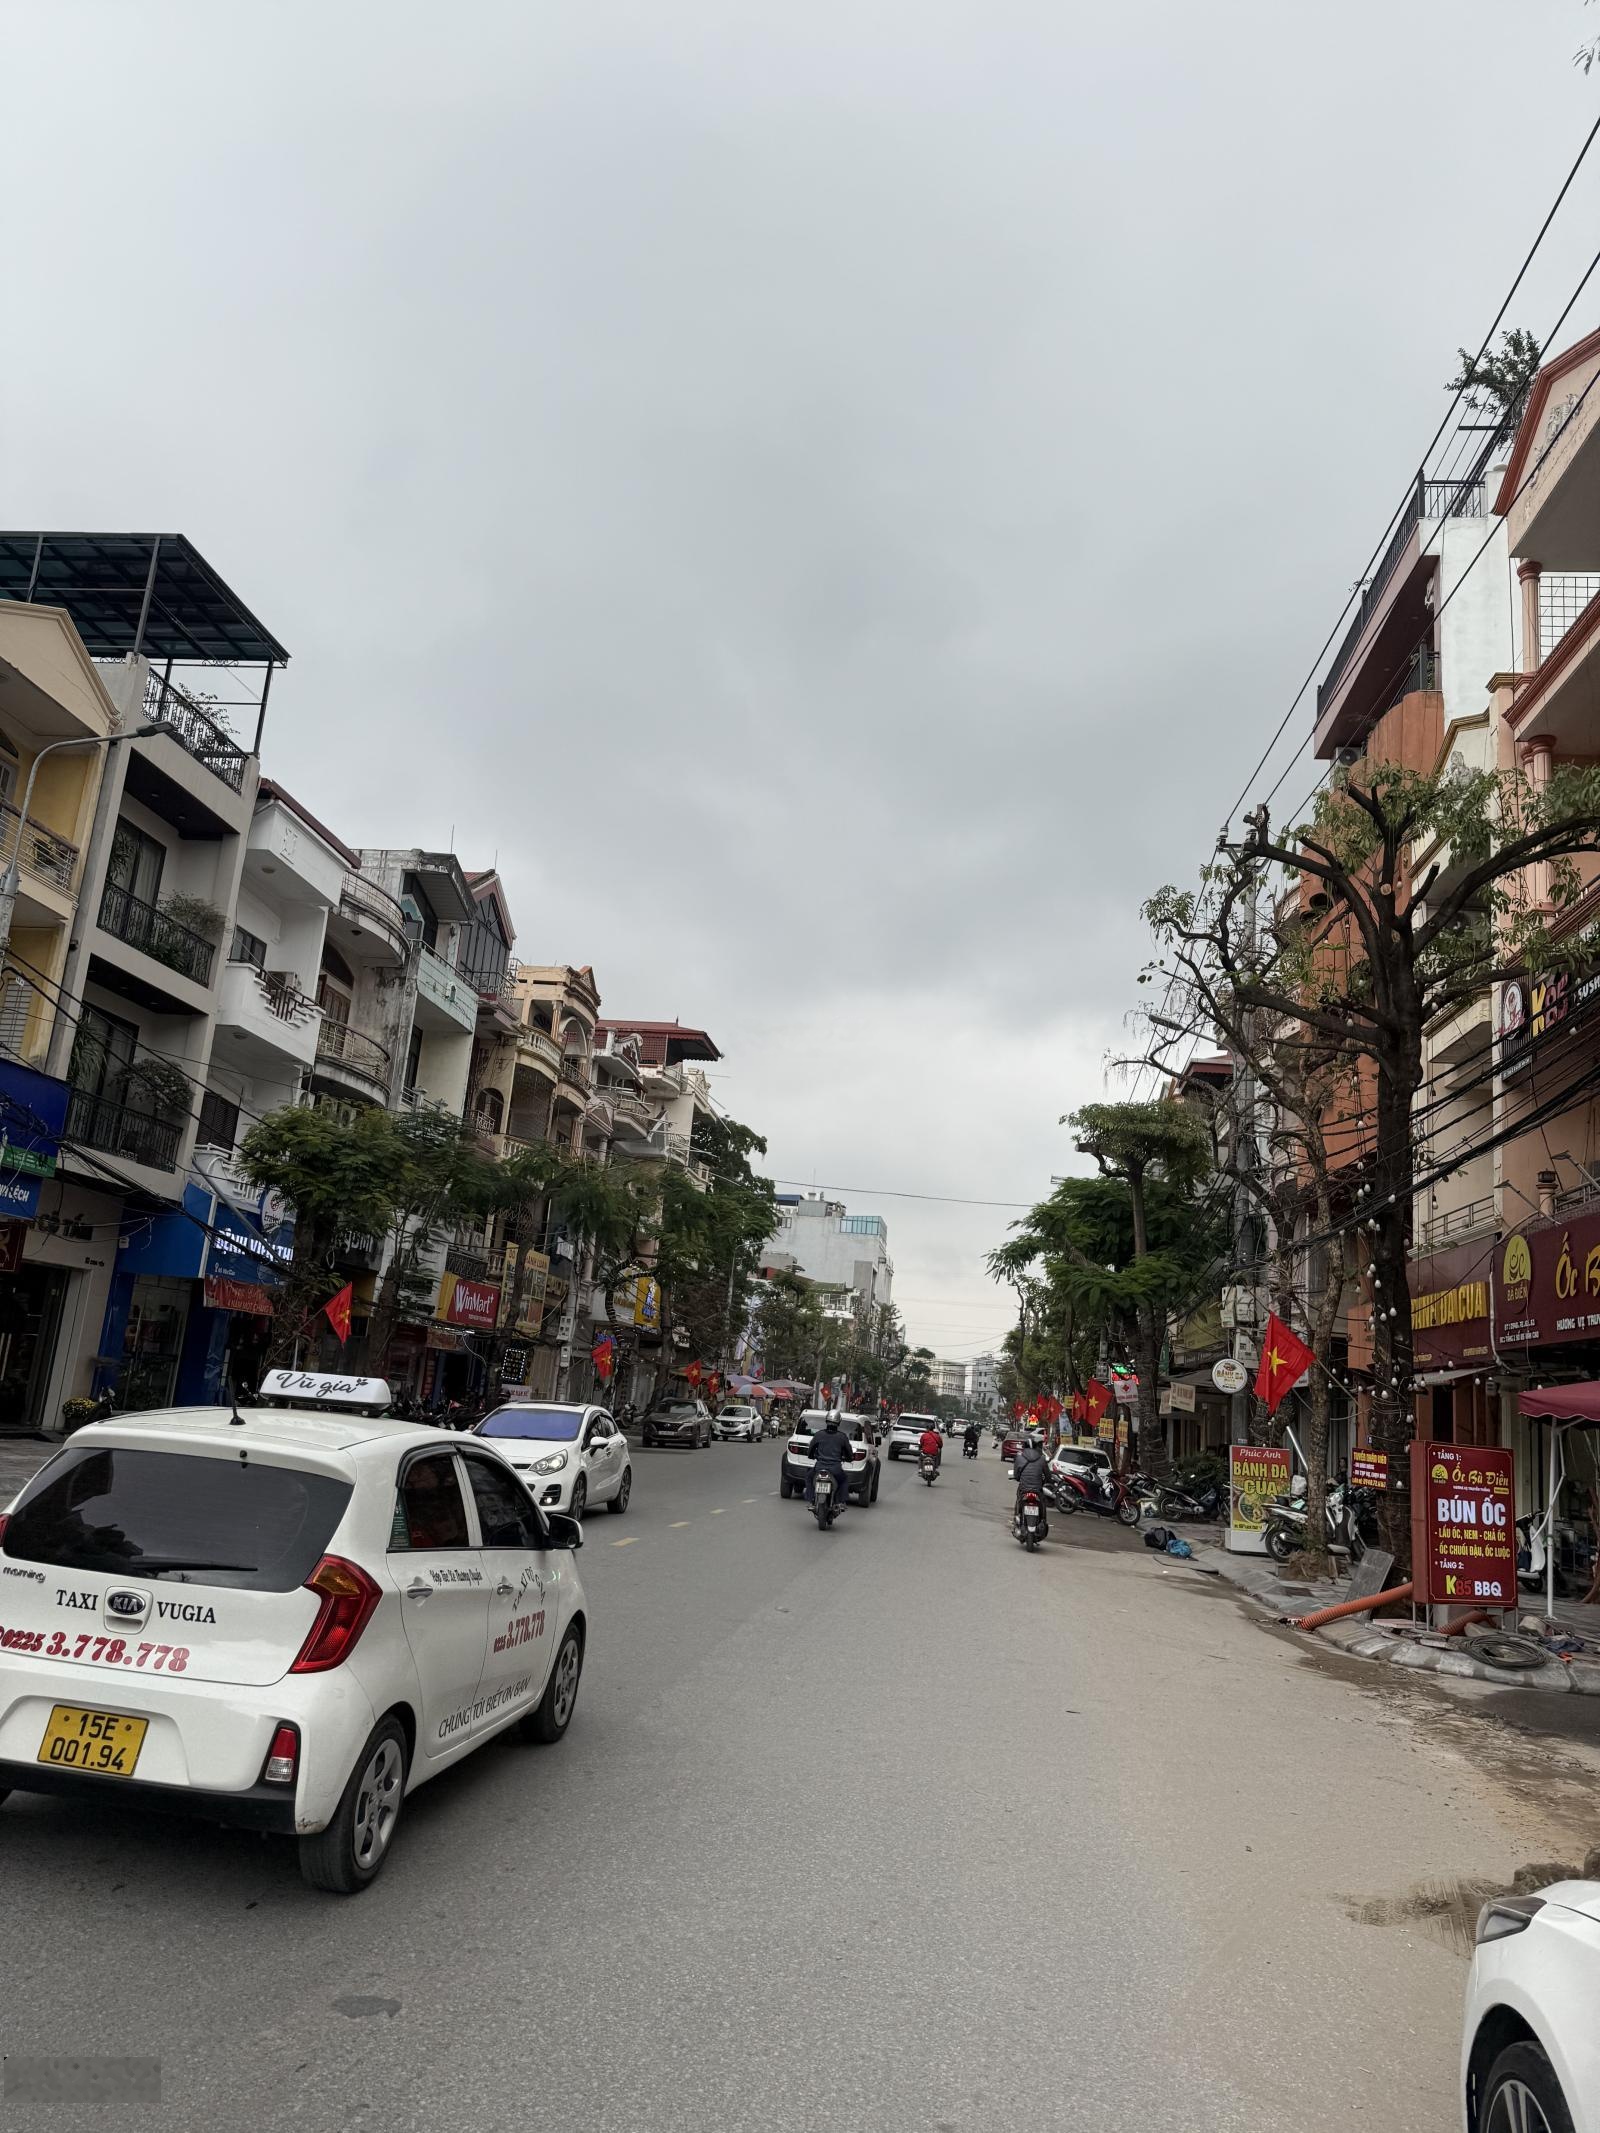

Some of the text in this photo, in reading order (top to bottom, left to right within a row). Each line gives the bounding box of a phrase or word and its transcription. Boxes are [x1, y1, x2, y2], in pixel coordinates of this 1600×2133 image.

[1556, 1232, 1579, 1299] Ốc
[1458, 1281, 1487, 1321] CUA
[277, 1372, 356, 1398] Vũ gia
[1239, 1448, 1281, 1459] Phúc Anh
[1233, 1459, 1288, 1479] BÁNH ĐA
[1452, 1462, 1509, 1486] Ốc Bà Điền
[1437, 1494, 1506, 1526] BÚN ỐC
[1463, 1529, 1478, 1540] NEM
[1439, 1541, 1448, 1555] ỐC
[1449, 1542, 1468, 1556] CHUỐI
[1484, 1543, 1494, 1557] ỐC
[3, 1566, 46, 1584] morning
[1445, 1574, 1502, 1597] K85 BBQ
[56, 1590, 99, 1611] TAXI
[112, 1596, 139, 1612] KIA
[157, 1602, 217, 1624] VUGIA
[506, 1610, 546, 1649] 3.778.778
[46, 1632, 191, 1672] 3.778.778
[79, 1713, 119, 1741] 15E
[438, 1705, 471, 1738] CHÚNG
[50, 1737, 127, 1770] 001.94
